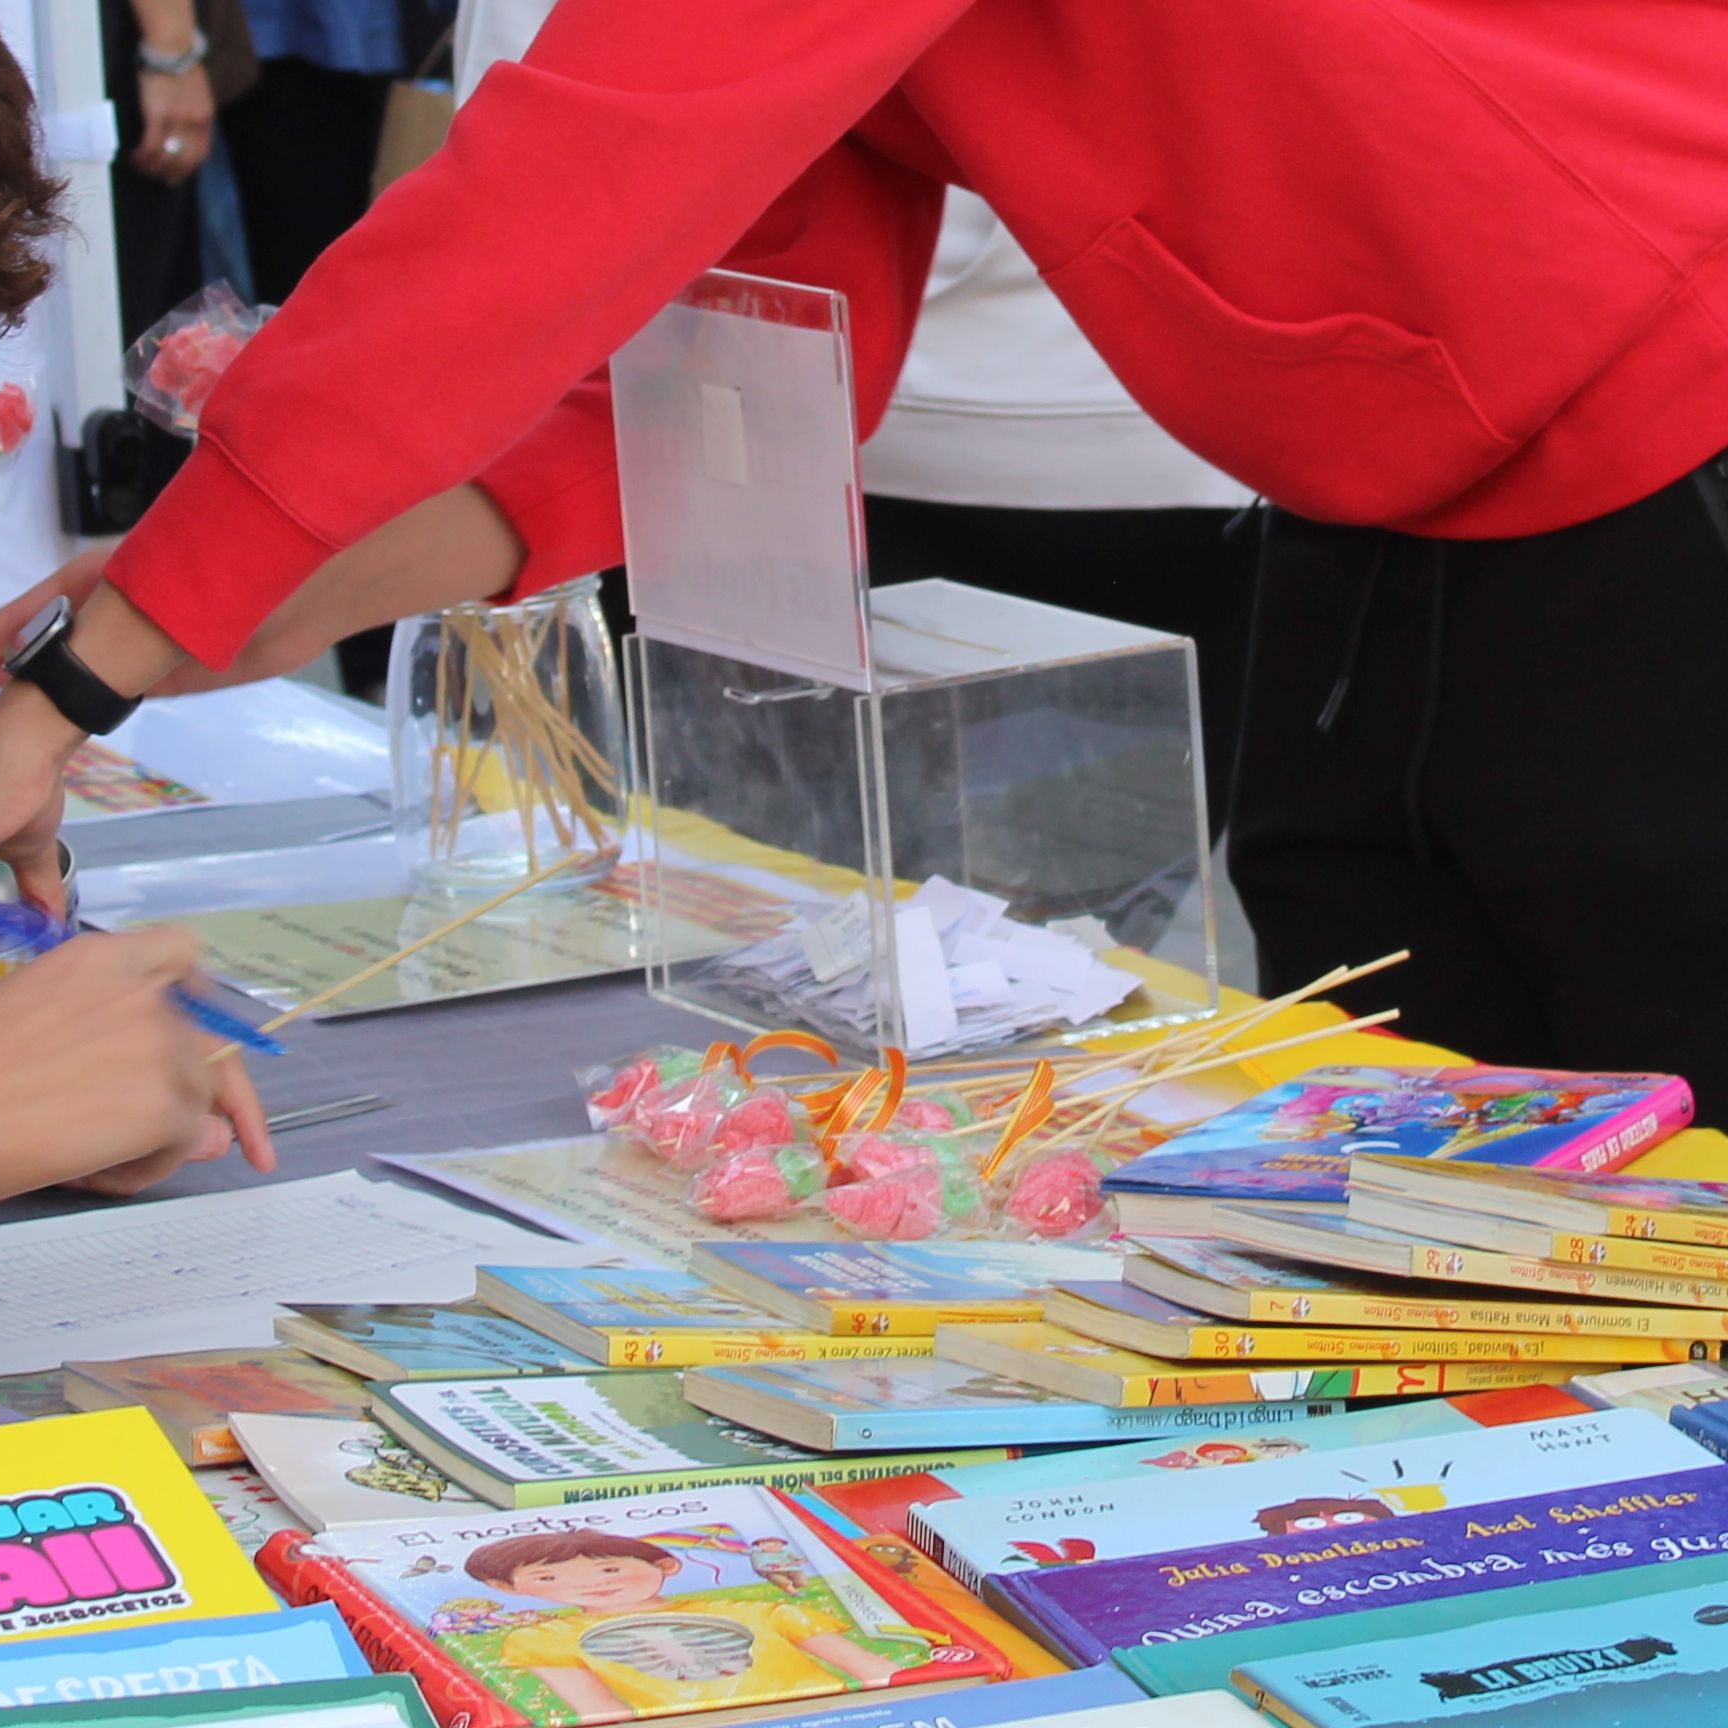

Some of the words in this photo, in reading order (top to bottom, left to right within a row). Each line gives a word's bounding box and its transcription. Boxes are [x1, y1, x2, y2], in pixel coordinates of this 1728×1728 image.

[1570, 1237, 1585, 1262] 28
[1650, 1252, 1685, 1272] Stilton
[1509, 1262, 1545, 1283] Stilton
[1549, 1268, 1595, 1291] Geronimo
[1604, 1274, 1665, 1294] Halloween
[1669, 1280, 1683, 1296] de
[1688, 1283, 1721, 1300] noche
[1363, 1303, 1402, 1321] Stilton
[1406, 1304, 1459, 1324] Geronimo
[1470, 1308, 1510, 1325] Ratisa
[1515, 1311, 1550, 1327] Mona
[1576, 1312, 1633, 1330] somriure
[1636, 1316, 1650, 1331] El
[623, 1340, 639, 1363] 43
[831, 1345, 860, 1359] Zero
[863, 1345, 893, 1359] Zero
[1215, 1331, 1230, 1356] 30
[1307, 1338, 1345, 1354] Stilton
[1349, 1338, 1402, 1355] Geronimo
[1412, 1338, 1459, 1354] Stilton!
[712, 1346, 751, 1362] Stilton
[756, 1346, 806, 1361] Geronimo
[1173, 1405, 1220, 1429] Drago
[1529, 1423, 1601, 1440] MATT
[1536, 1435, 1611, 1454] HUNT
[1010, 1493, 1086, 1512] JOHN
[393, 1529, 444, 1546] El
[452, 1509, 609, 1539] nostre
[625, 1497, 709, 1520] cos
[1005, 1502, 1116, 1523] CONDON
[1159, 1559, 1251, 1590] Julia
[1260, 1532, 1425, 1568] Donaldson
[1463, 1509, 1538, 1540] Axel
[1547, 1487, 1697, 1523] Scheffler
[1296, 1546, 1524, 1608] escombra
[1543, 1525, 1634, 1567] més
[1471, 1668, 1516, 1689] LA
[1518, 1646, 1634, 1680] BRUIXA
